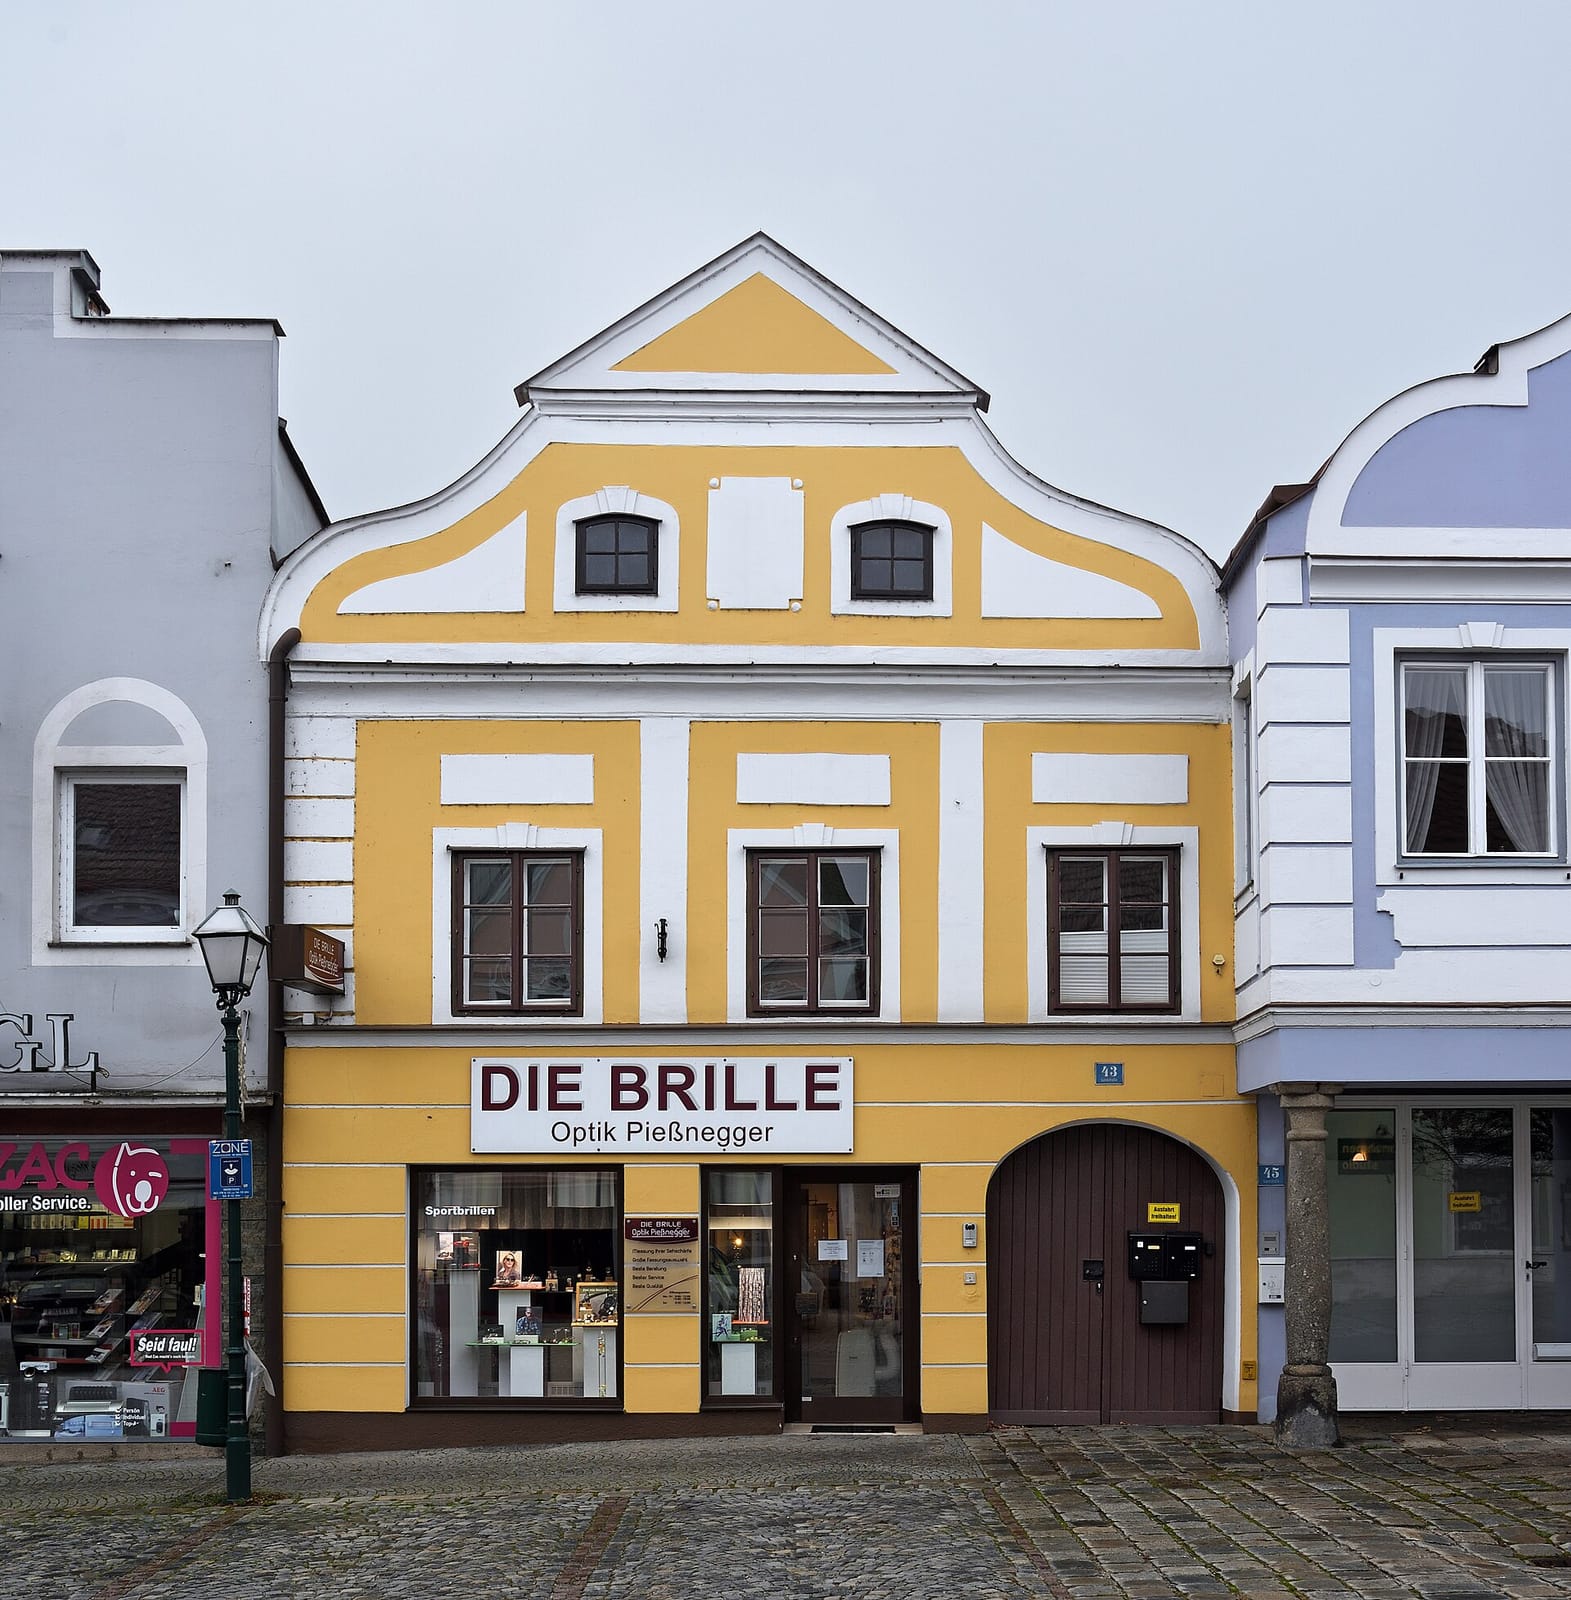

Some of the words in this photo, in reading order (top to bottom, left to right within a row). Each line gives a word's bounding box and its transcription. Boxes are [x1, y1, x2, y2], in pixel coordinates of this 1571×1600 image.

[1101, 1065, 1118, 1077] 43
[481, 1065, 583, 1111] DIE
[610, 1065, 841, 1111] BRILLE
[551, 1121, 617, 1145] Optik
[627, 1121, 774, 1146] Pießnegger
[212, 1142, 249, 1153] ZONE
[1263, 1167, 1280, 1178] 45
[32, 1195, 91, 1210] Service.
[425, 1206, 495, 1217] Sportbrillen
[631, 1228, 650, 1237] Optik
[650, 1228, 690, 1238] Pießnegger
[137, 1336, 166, 1352] Seid
[168, 1336, 197, 1352] faul!
